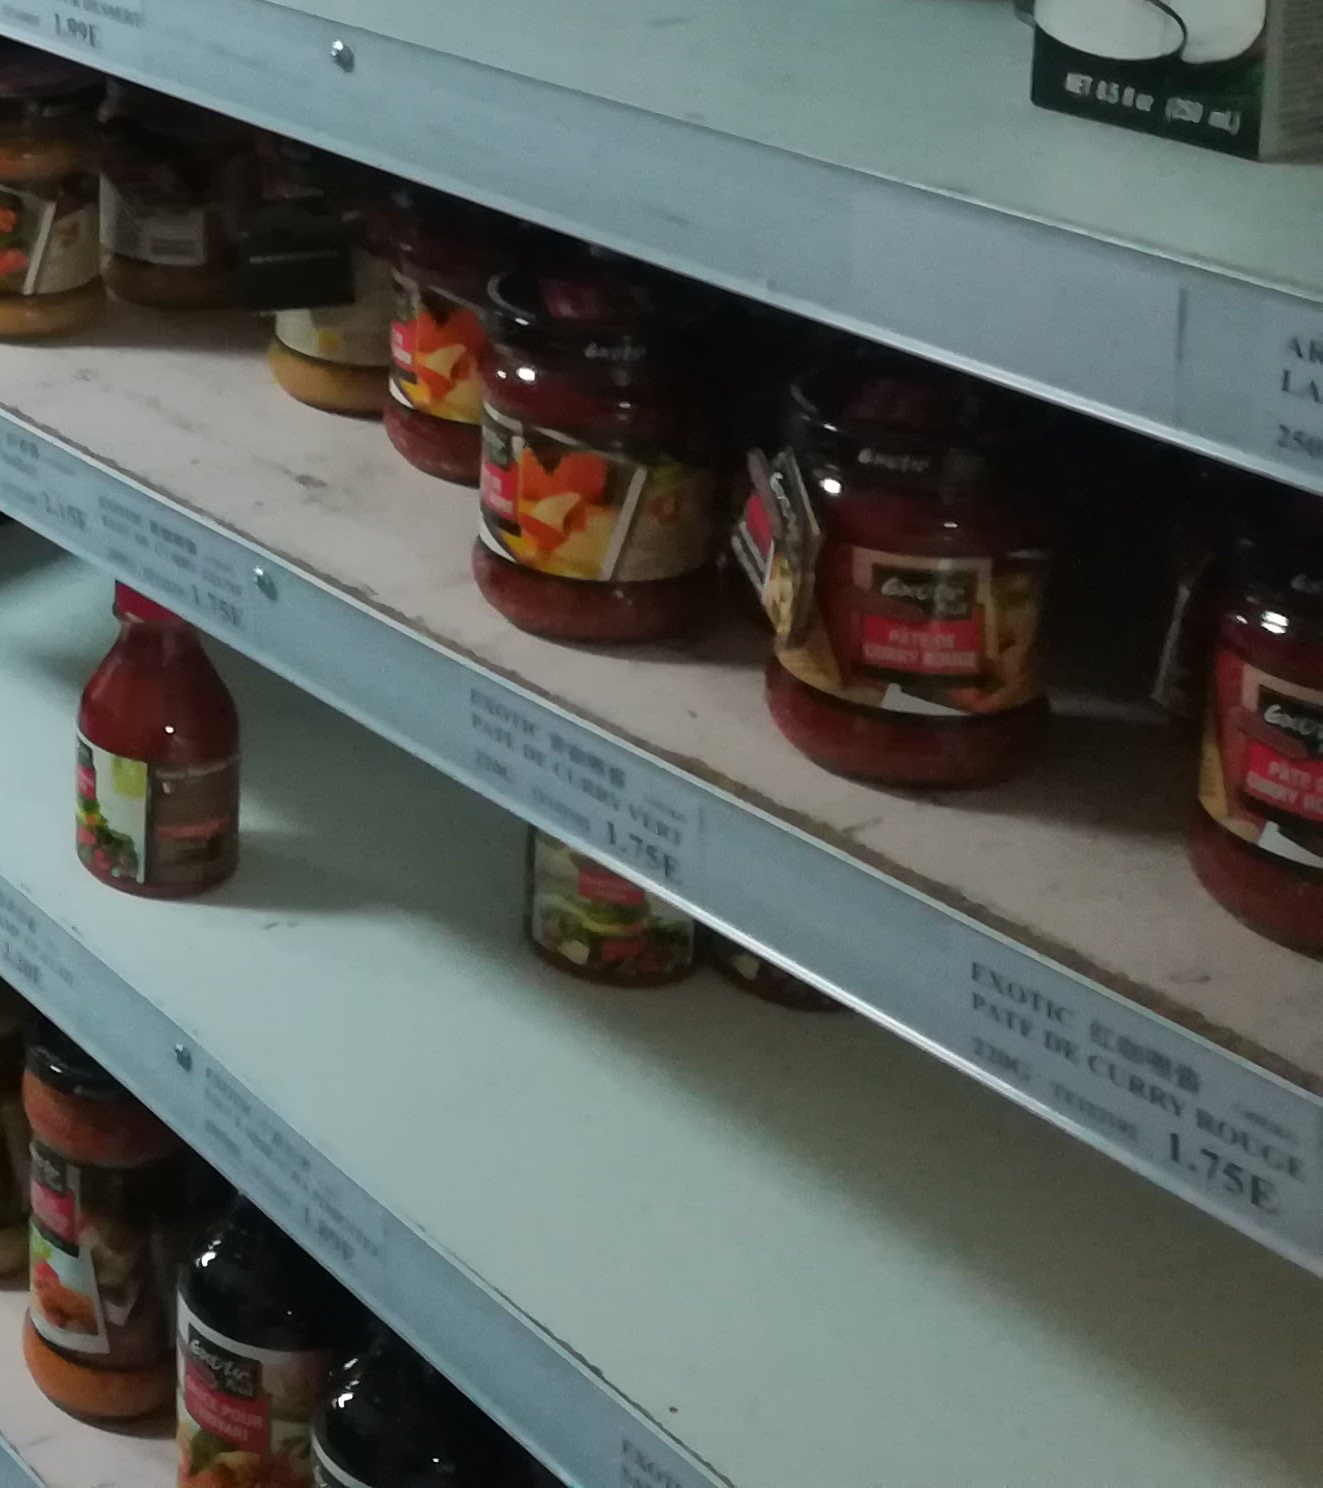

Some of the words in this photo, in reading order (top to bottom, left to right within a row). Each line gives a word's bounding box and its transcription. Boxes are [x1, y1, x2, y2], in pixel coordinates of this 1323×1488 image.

[971, 961, 1074, 1024] EXOTIC
[1086, 1053, 1187, 1117] CURRY
[1195, 1107, 1307, 1183] ROUGE
[1168, 1131, 1281, 1217] 1.75E
